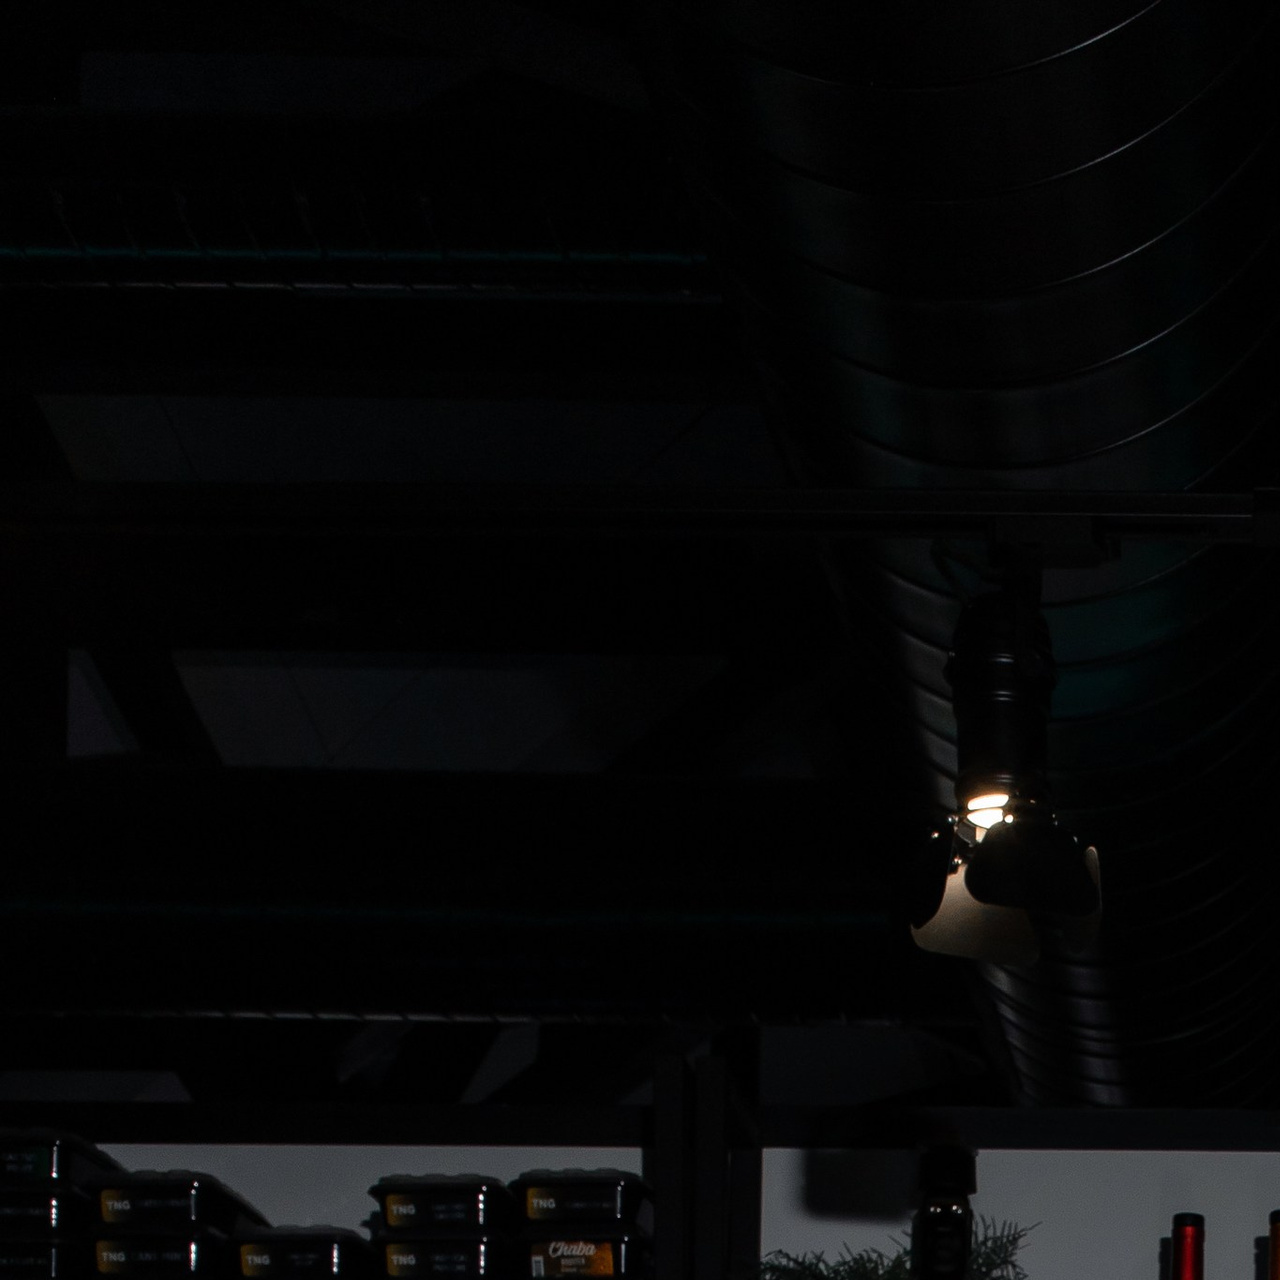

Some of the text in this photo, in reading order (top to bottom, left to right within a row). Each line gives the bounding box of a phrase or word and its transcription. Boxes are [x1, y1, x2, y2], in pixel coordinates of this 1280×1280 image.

[107, 1201, 130, 1210] TNG
[533, 1198, 555, 1208] TNG
[392, 1205, 415, 1214] TNG
[102, 1252, 125, 1261] TNG
[247, 1255, 269, 1265] TNG
[392, 1255, 415, 1265] TNG
